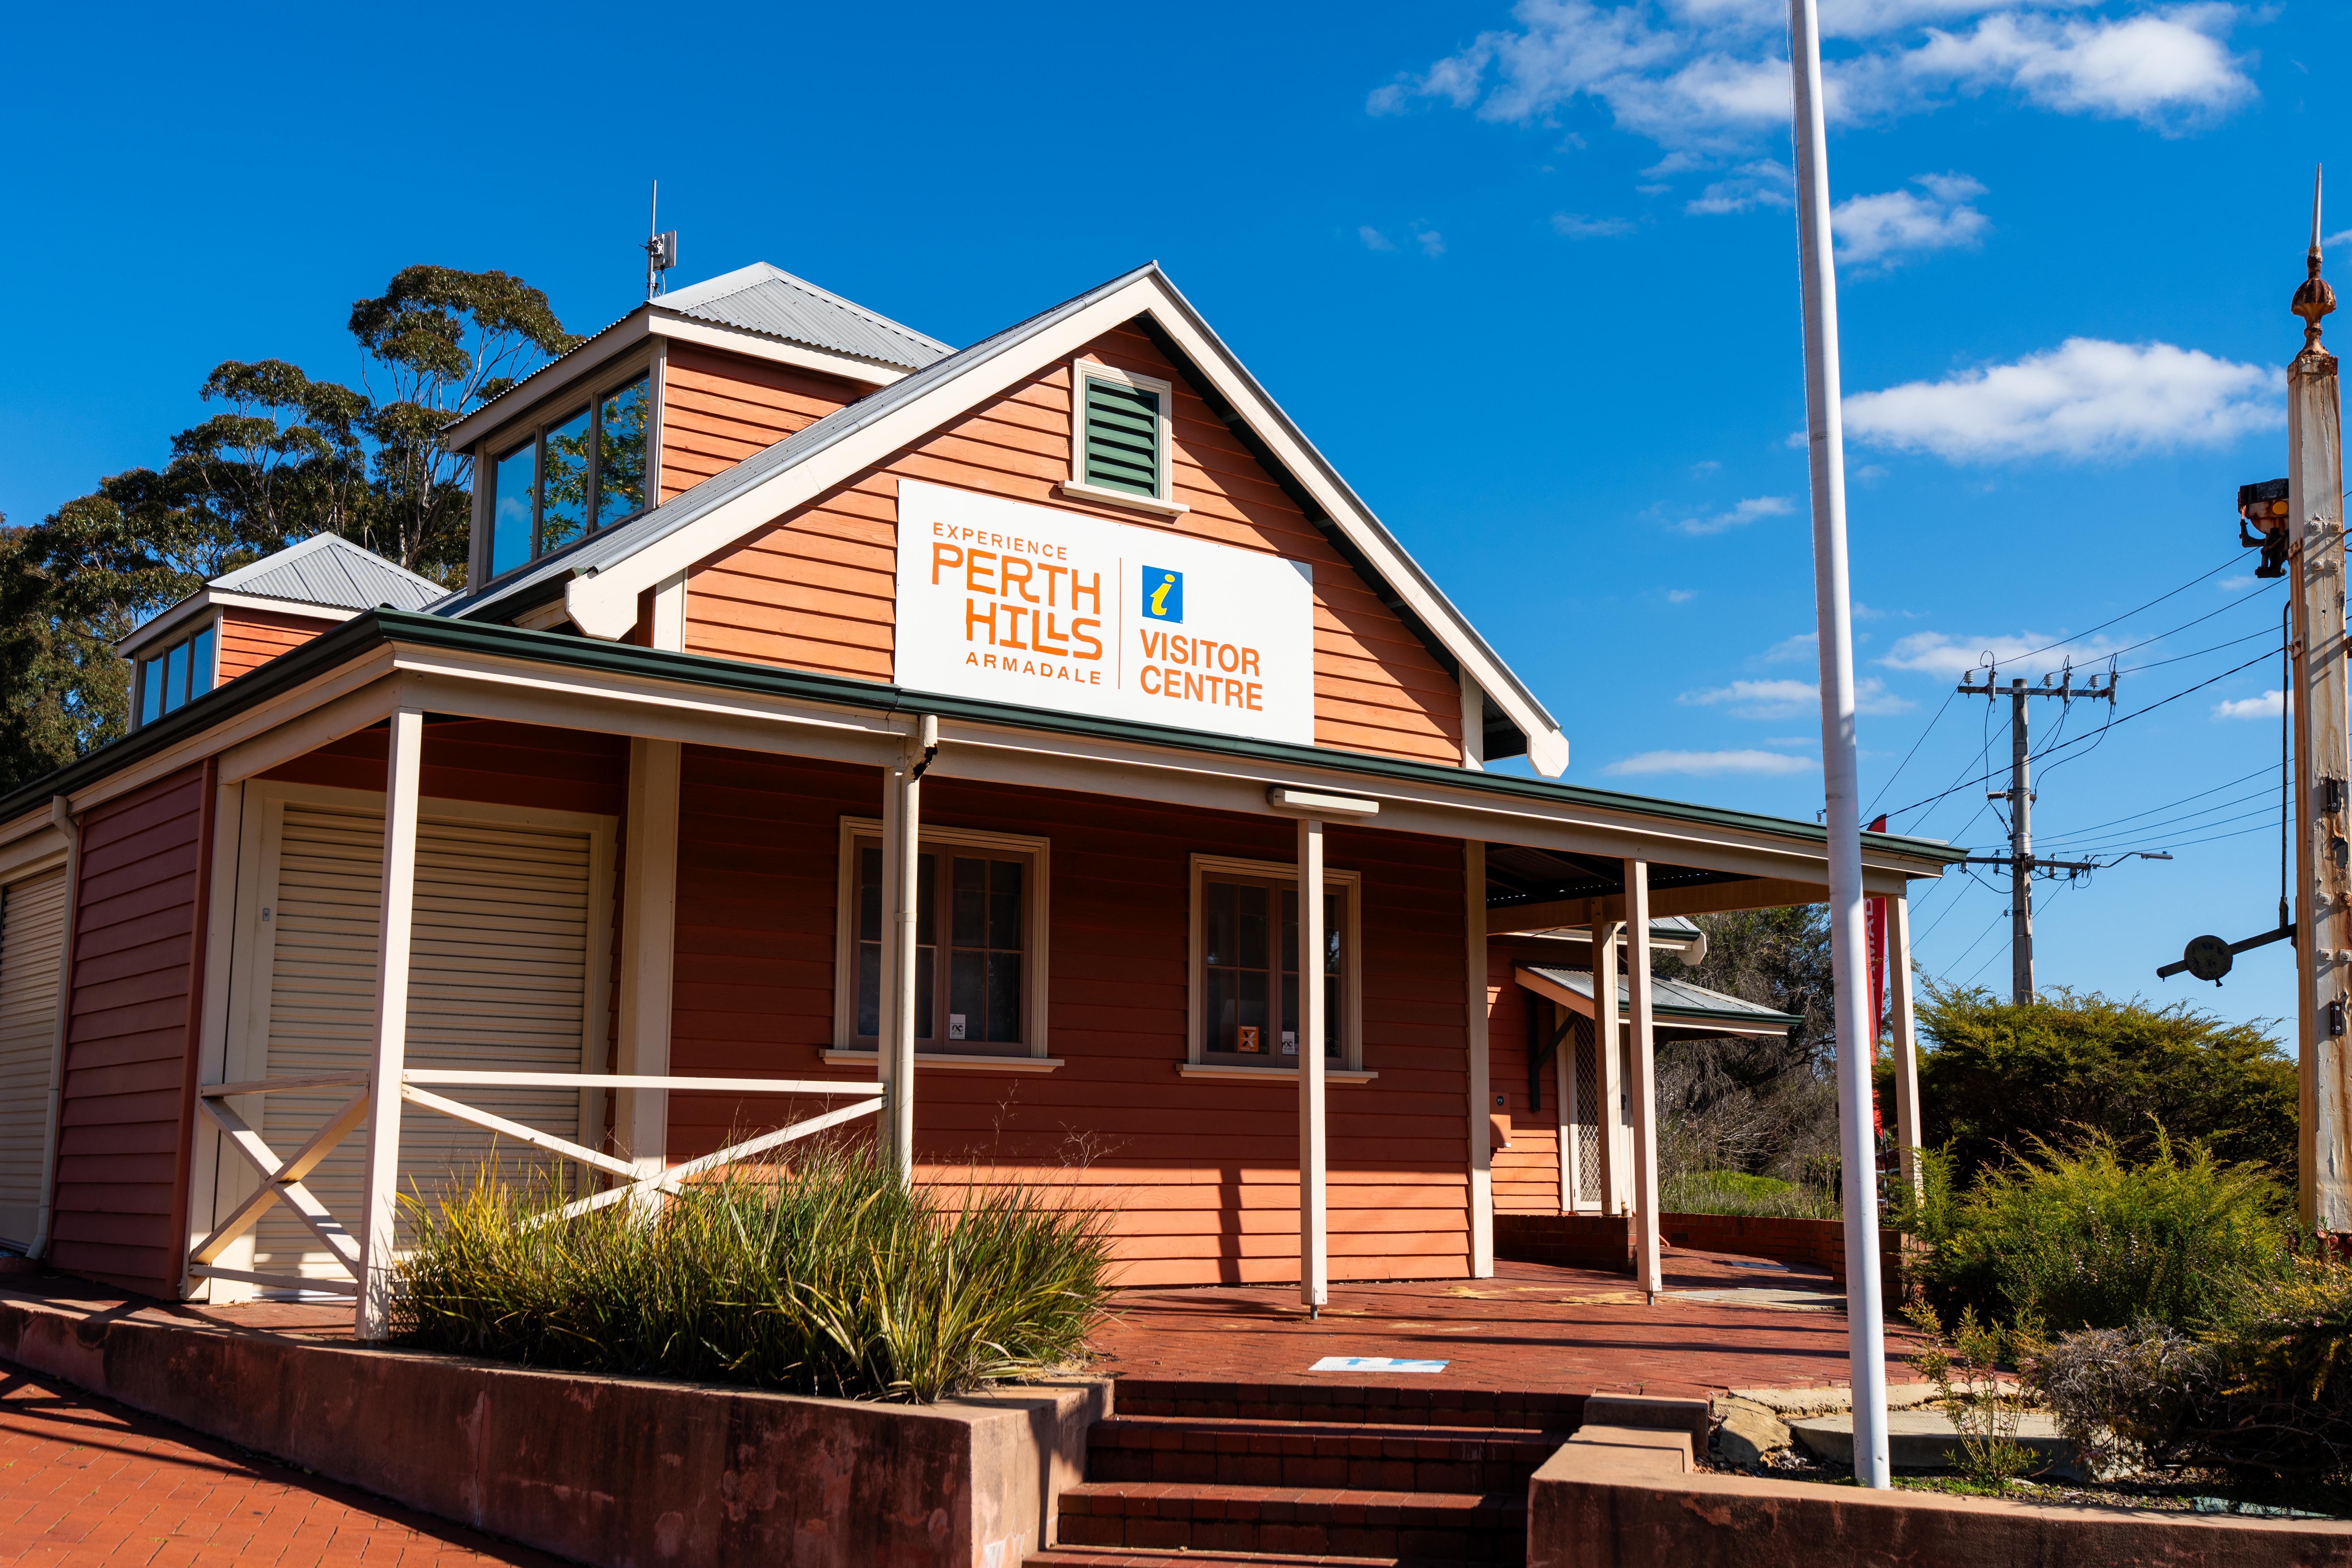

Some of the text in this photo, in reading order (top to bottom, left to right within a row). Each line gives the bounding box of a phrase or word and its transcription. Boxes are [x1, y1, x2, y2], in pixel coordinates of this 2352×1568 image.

[933, 522, 1067, 560] EXPERIENCE
[932, 542, 1100, 615] PERTH
[966, 598, 1102, 660] HILLS
[966, 652, 1101, 684] ARMADALE
[1140, 629, 1259, 677] VISITOR
[1140, 665, 1262, 711] CENTRE
